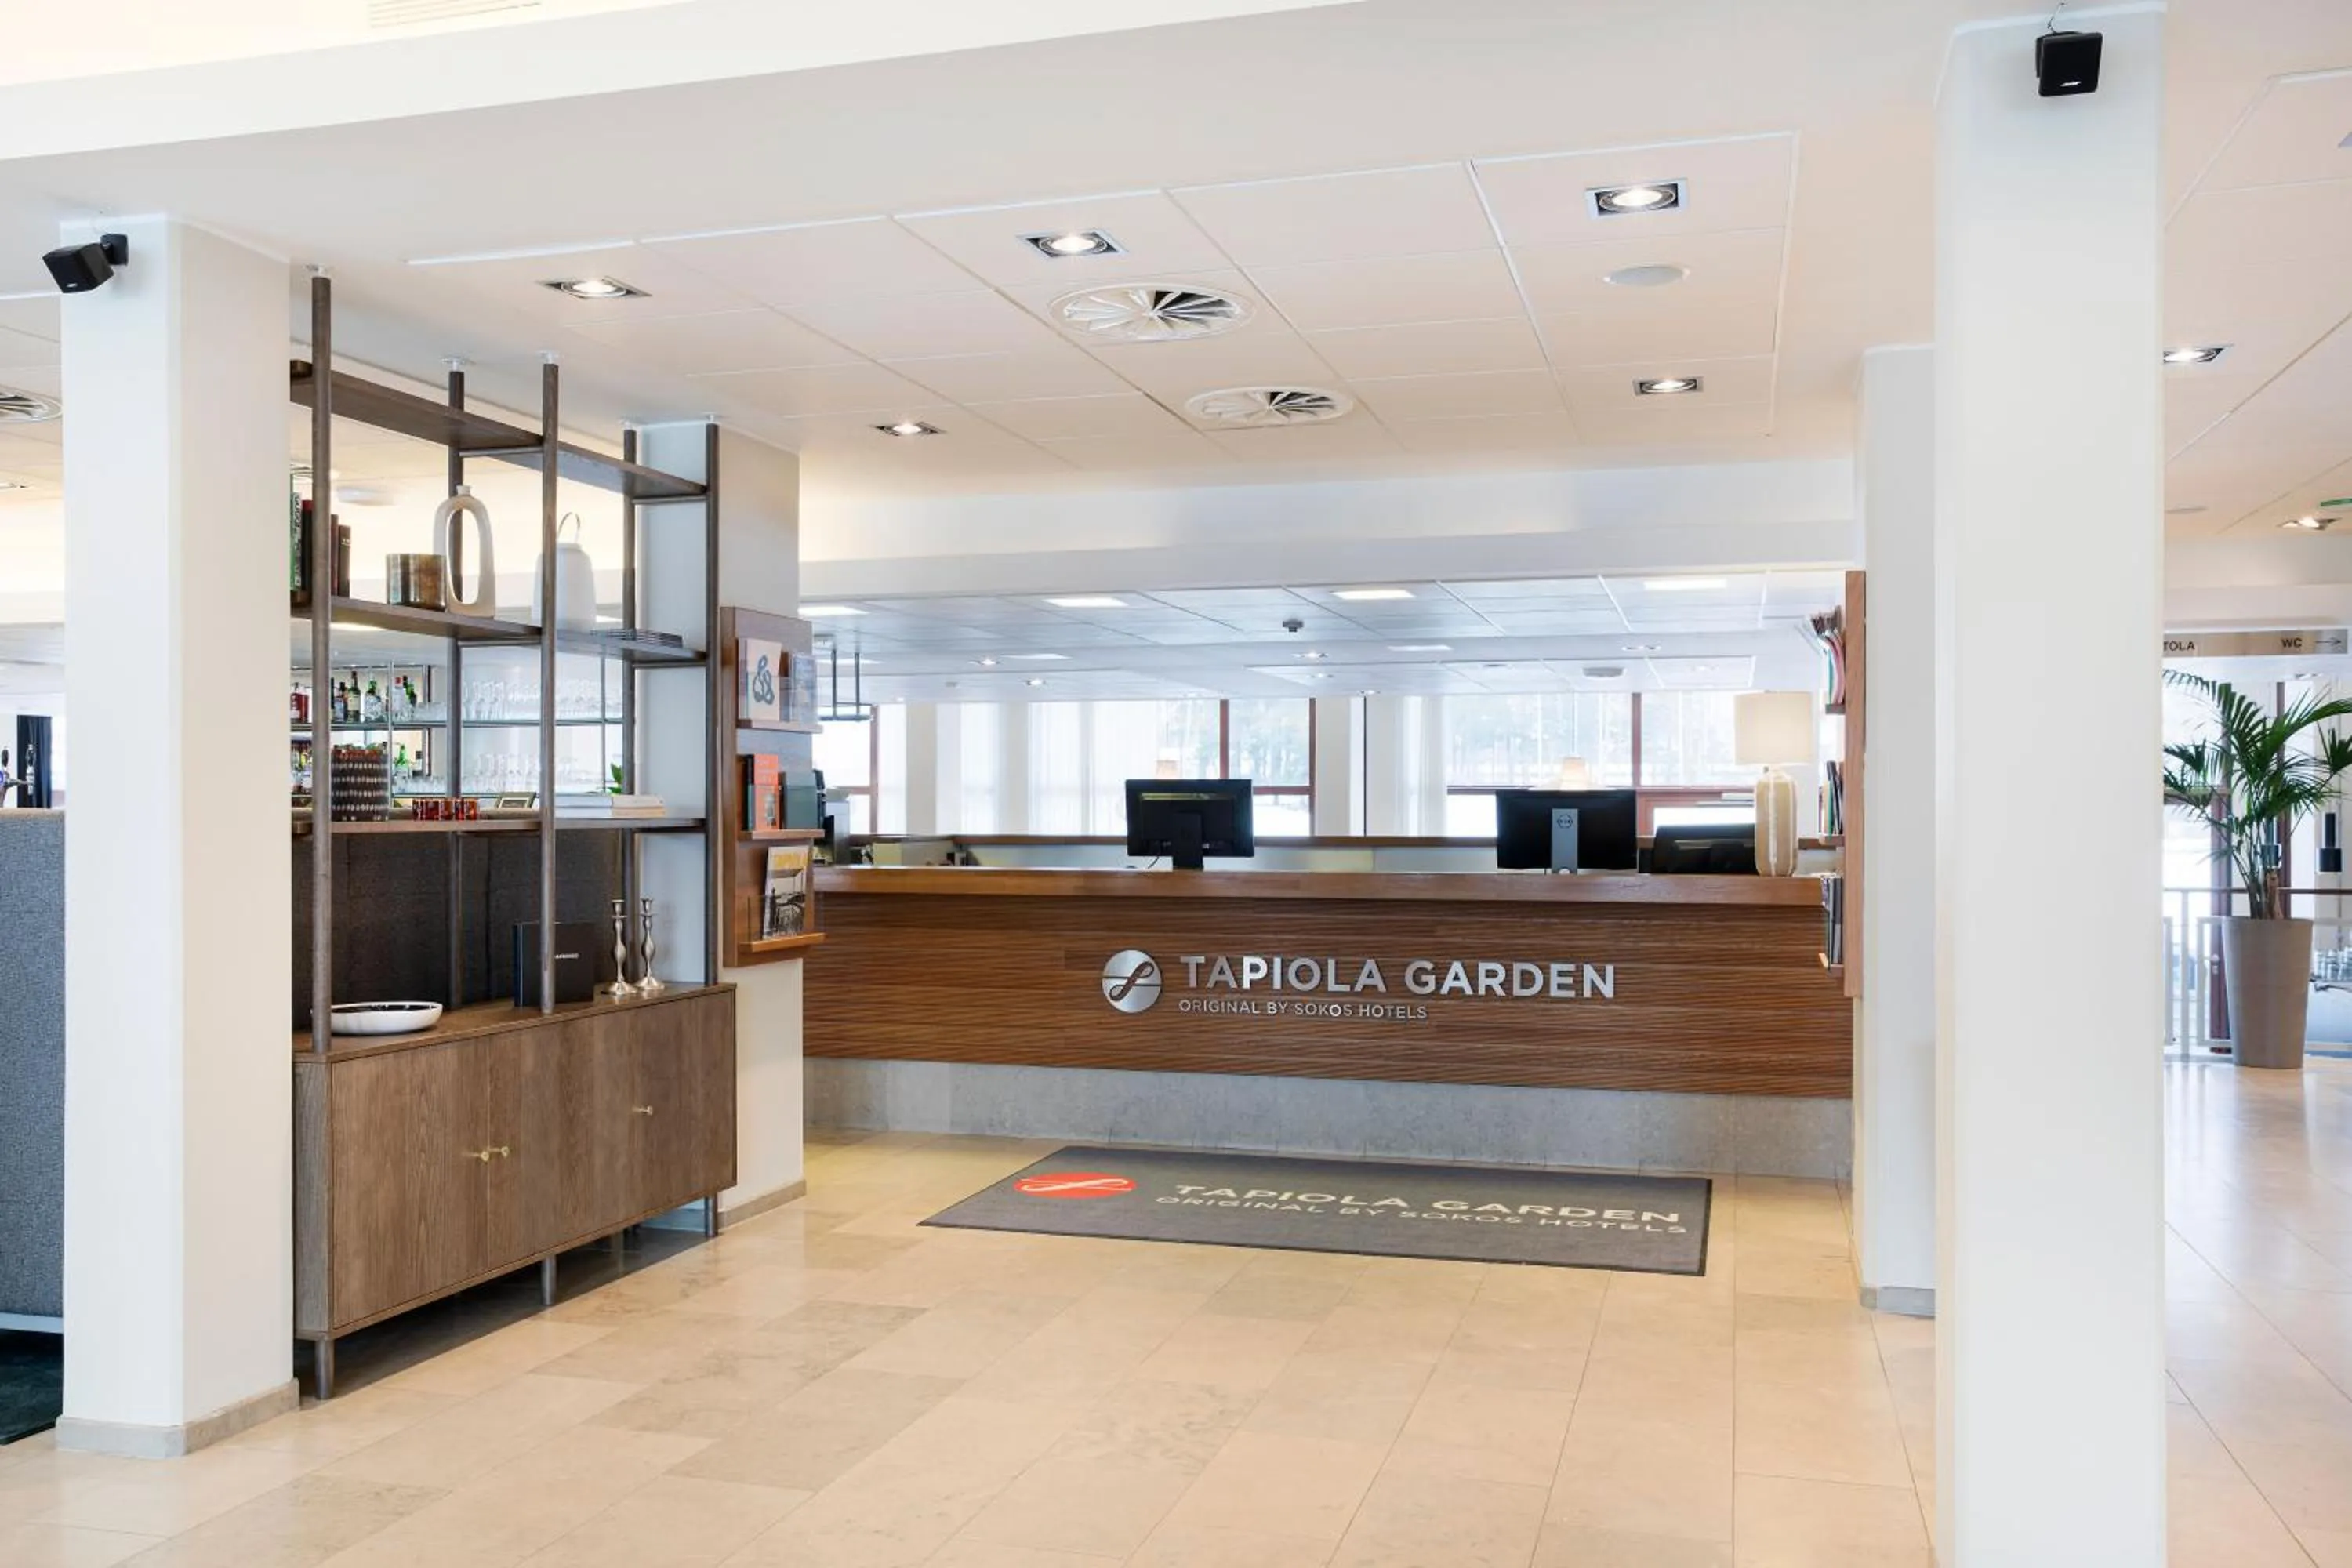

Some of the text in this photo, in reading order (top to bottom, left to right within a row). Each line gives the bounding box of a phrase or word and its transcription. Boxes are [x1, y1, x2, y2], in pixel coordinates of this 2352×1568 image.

[2281, 637, 2303, 648] WC
[1179, 955, 1614, 998] TAPIOLA GARDEN
[1178, 1000, 1428, 1019] ORIGINAL BY SOKOS HOTELS
[1155, 1196, 1687, 1234] ORIGINAL BY SOKOS HOTELS
[1176, 1185, 1679, 1223] TAPIOLA GARDEN
